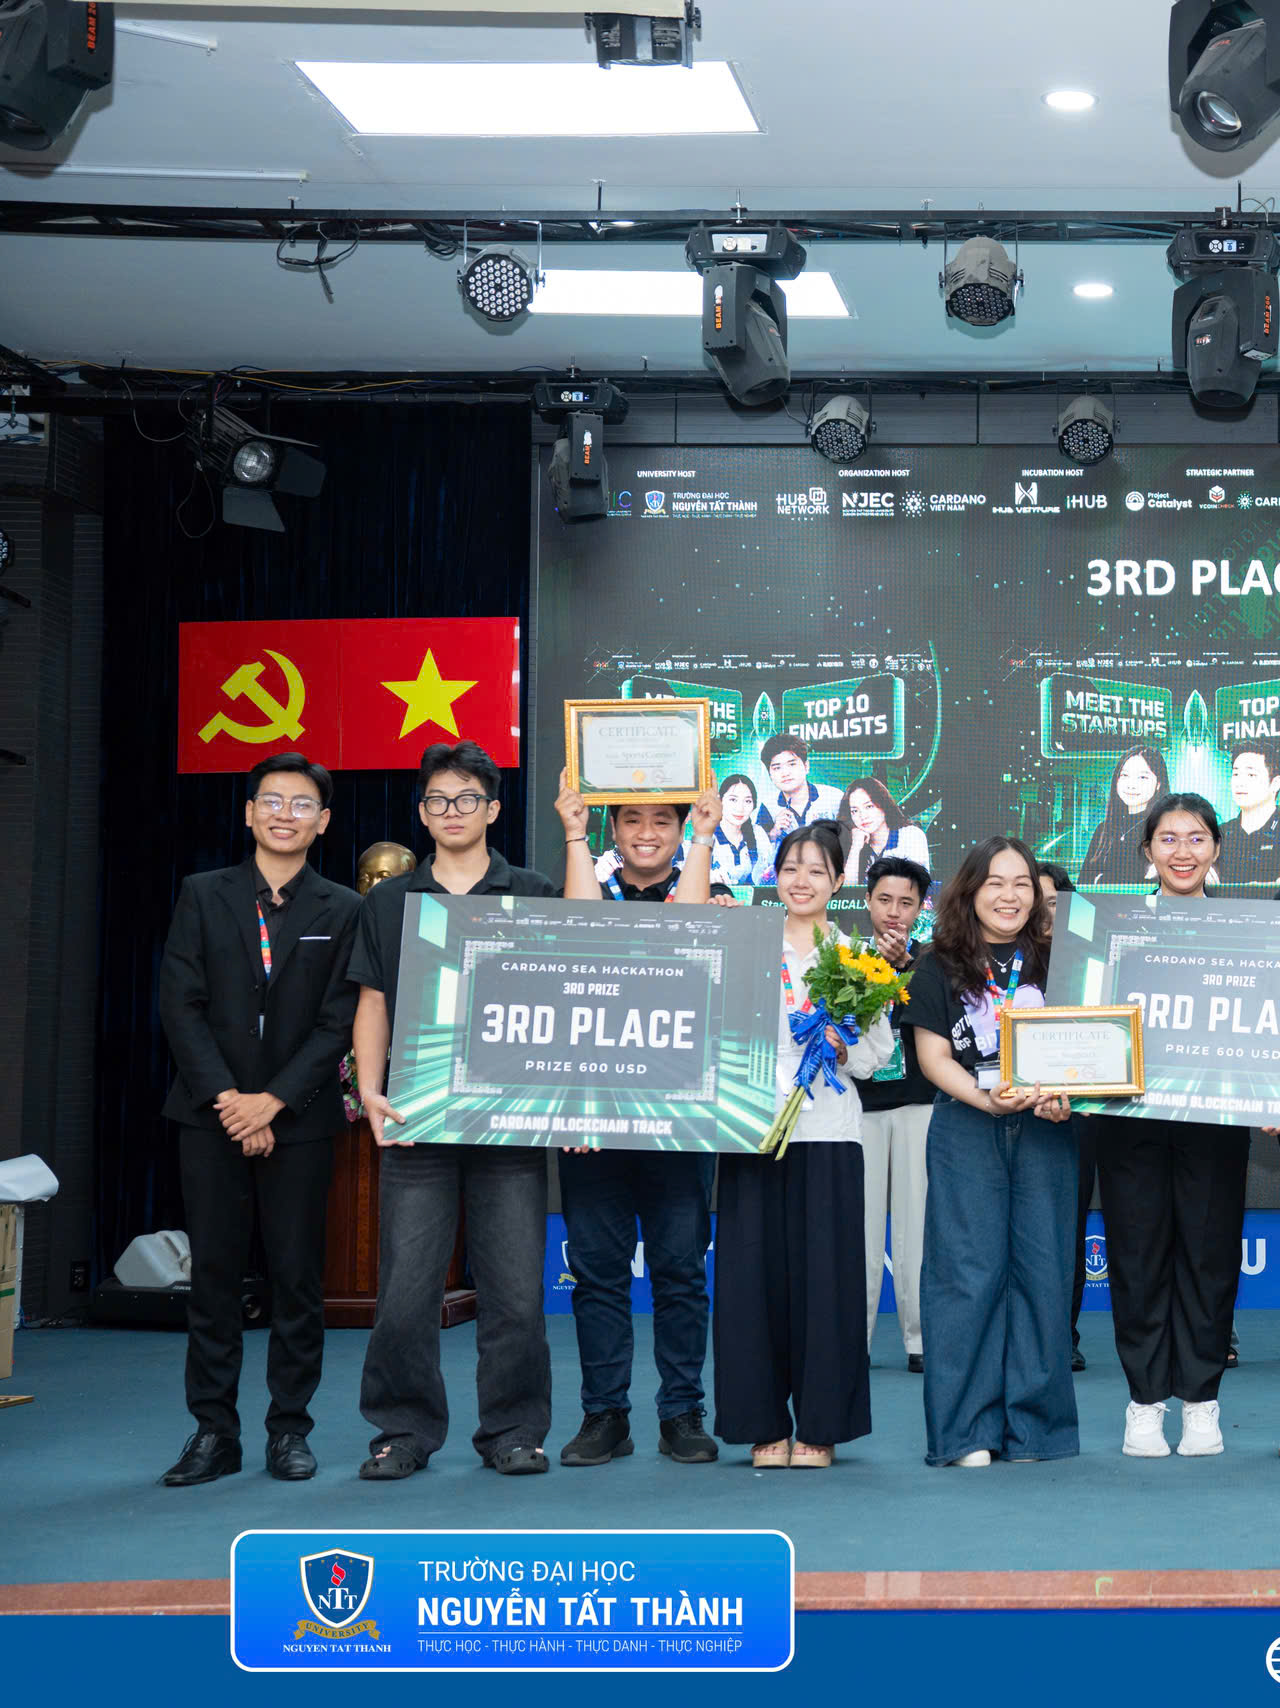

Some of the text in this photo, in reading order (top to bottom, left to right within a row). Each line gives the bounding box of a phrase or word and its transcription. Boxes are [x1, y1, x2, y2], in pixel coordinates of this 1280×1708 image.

[636, 470, 696, 478] UNIVERSITY HOST
[838, 469, 910, 477] ORGANIZATION HOST
[776, 493, 808, 505] HUB
[929, 494, 986, 504] CARDANO
[1148, 499, 1193, 510] Catalyst
[777, 505, 830, 514] NETWORK
[1087, 559, 1175, 597] 3RD
[803, 693, 870, 719] TOP 10
[1065, 690, 1165, 718] MEET THE
[1238, 697, 1279, 716] TOP
[598, 725, 678, 738] CERTIFICATE
[788, 714, 888, 742] FINALISTS
[1061, 713, 1168, 739] STARTUPS
[1144, 954, 1206, 967] CARDANO
[1210, 957, 1235, 968] SEA
[501, 961, 685, 978] CARDANO SEA HACKATHON
[1202, 974, 1257, 988] 3RD PRIZE
[562, 982, 621, 997] 3RD PRIZE
[481, 1003, 697, 1050] 3RD PLACE
[1032, 1030, 1112, 1041] CERTIFICATE
[1165, 1044, 1210, 1056] PRIZE
[1216, 1047, 1245, 1058] 600
[525, 1060, 648, 1075] PRIZE 600 USD
[1132, 1092, 1187, 1108] CARDANO
[1190, 1095, 1263, 1113] BLOCKCHAIN
[490, 1115, 673, 1136] CARDANO BLOCKCHAIN TRACK
[1086, 1254, 1106, 1266] NTT
